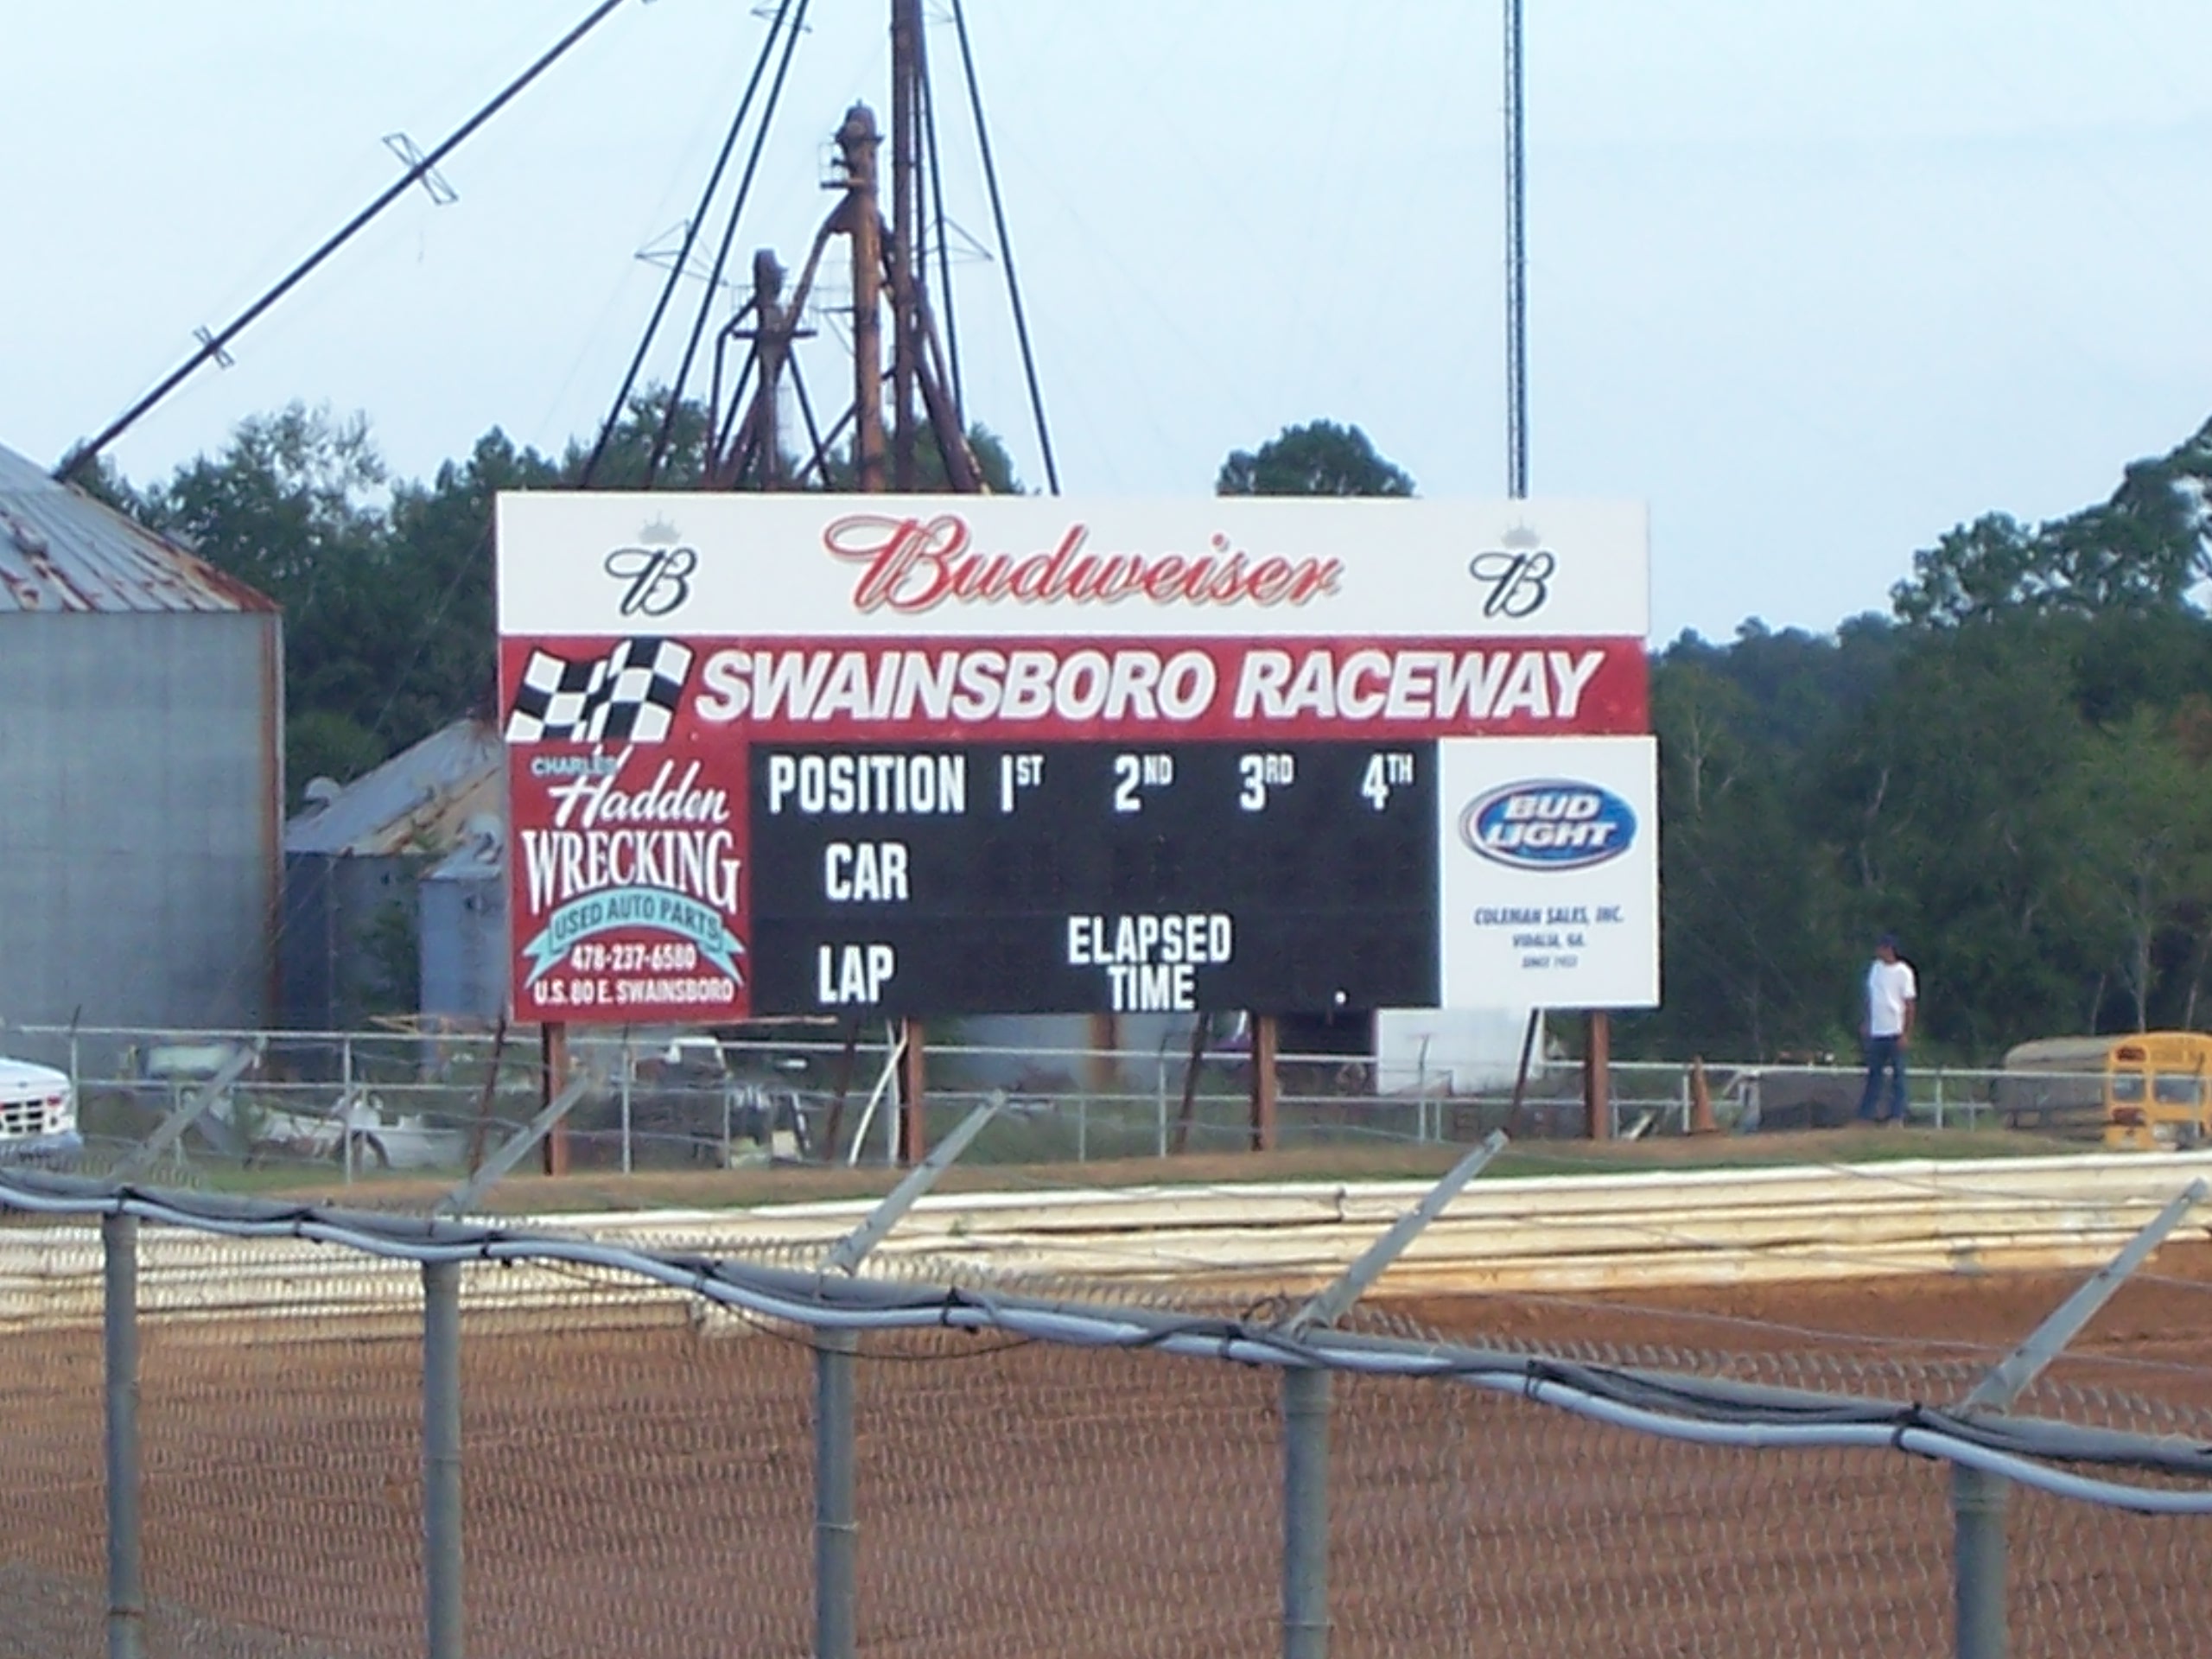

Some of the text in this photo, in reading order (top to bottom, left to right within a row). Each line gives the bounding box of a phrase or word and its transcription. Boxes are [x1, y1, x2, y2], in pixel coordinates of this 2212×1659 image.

[823, 513, 1345, 615] Budweiser
[694, 650, 1605, 721] SWAINSBORO RACEWAY
[548, 745, 730, 828] Hadden
[769, 754, 965, 813] POSITION
[1114, 753, 1173, 811] 2ND
[1238, 753, 1294, 811] 3RD
[1361, 753, 1414, 810] 4TH
[1503, 792, 1601, 820] BUD
[1484, 822, 1618, 847] LIGHT
[521, 830, 741, 915] WRECKING
[824, 842, 908, 901] CAR
[554, 893, 719, 940] USED AUTO PARTS
[1068, 914, 1232, 964] ELAPSED
[534, 977, 568, 1005] U.S.
[616, 976, 734, 1004] SWAINSBORO
[818, 944, 895, 1003] LAP
[1106, 964, 1196, 1012] TIME
